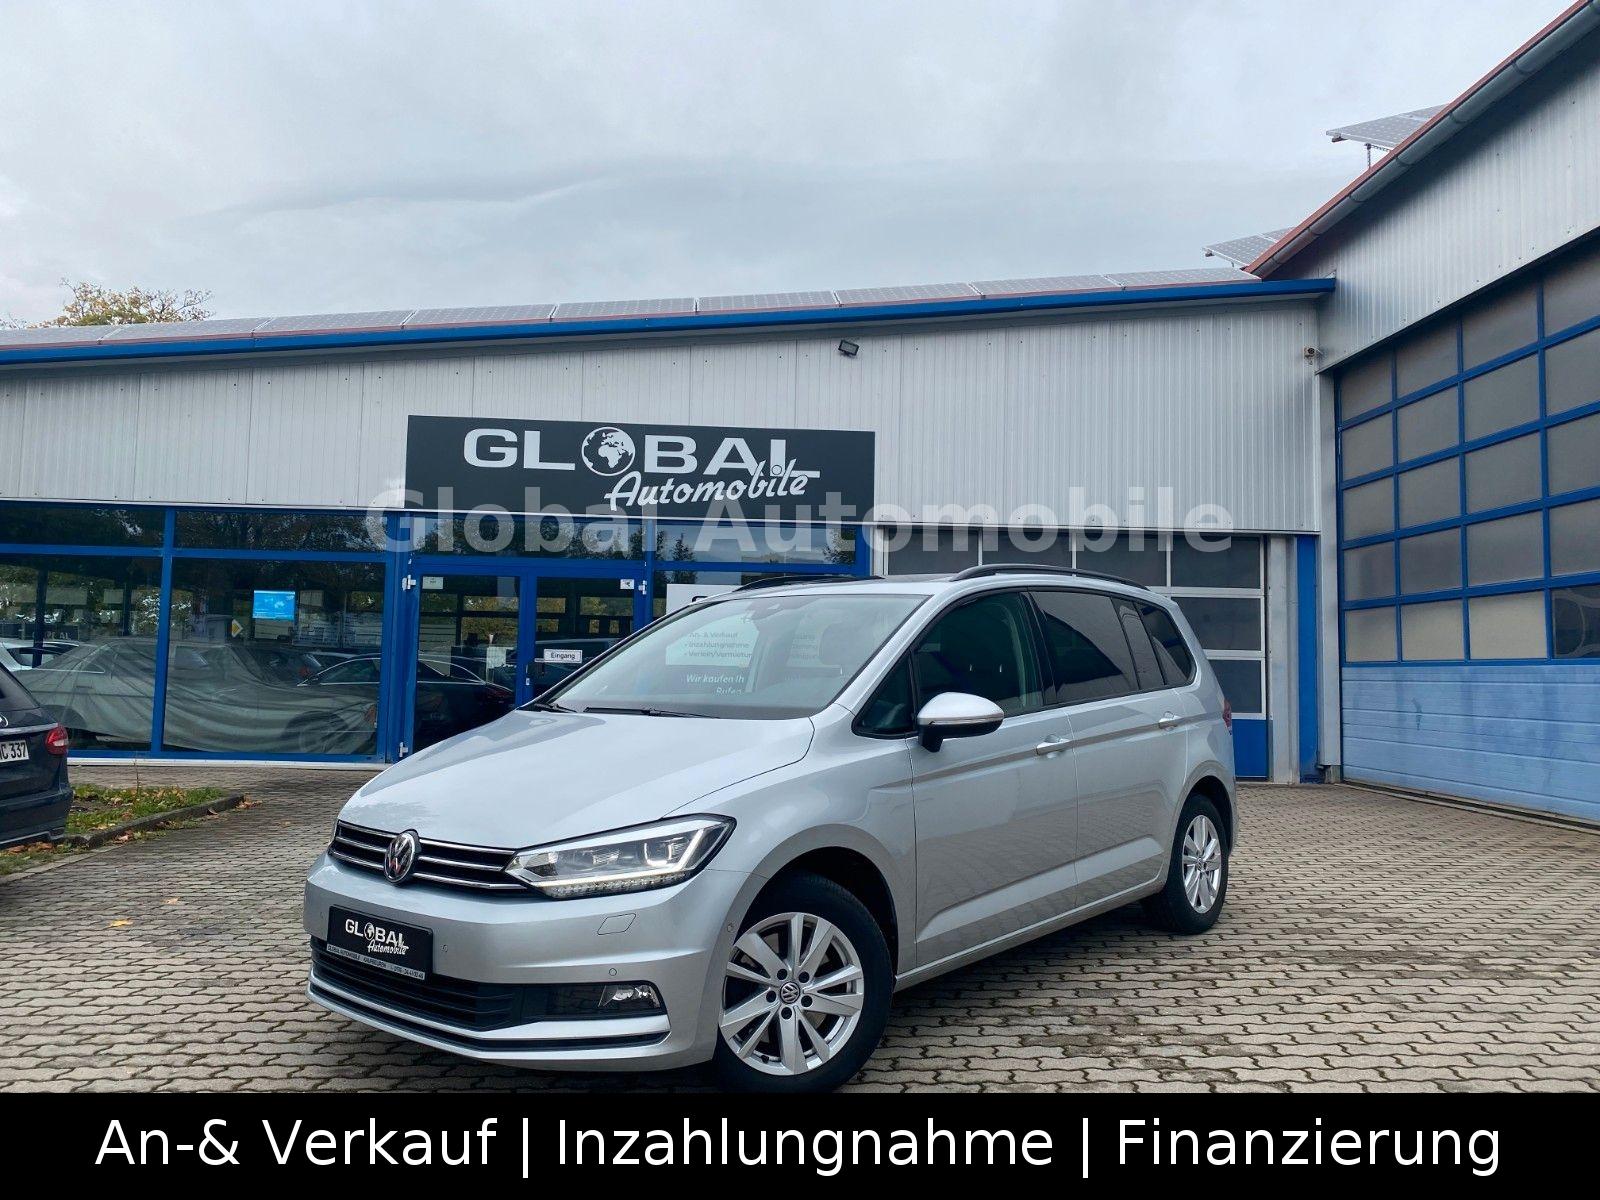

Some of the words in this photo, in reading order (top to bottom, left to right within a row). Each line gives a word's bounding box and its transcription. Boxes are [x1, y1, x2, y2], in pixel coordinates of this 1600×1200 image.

[464, 426, 820, 478] GLOBAL
[604, 458, 808, 511] Automobile
[551, 652, 576, 661] Eingang
[686, 674, 701, 683] Wir
[703, 673, 734, 683] kaufen
[0, 743, 8, 760] C
[9, 742, 26, 759] 337
[345, 919, 409, 949] GLOBAL
[367, 939, 408, 955] Automobile
